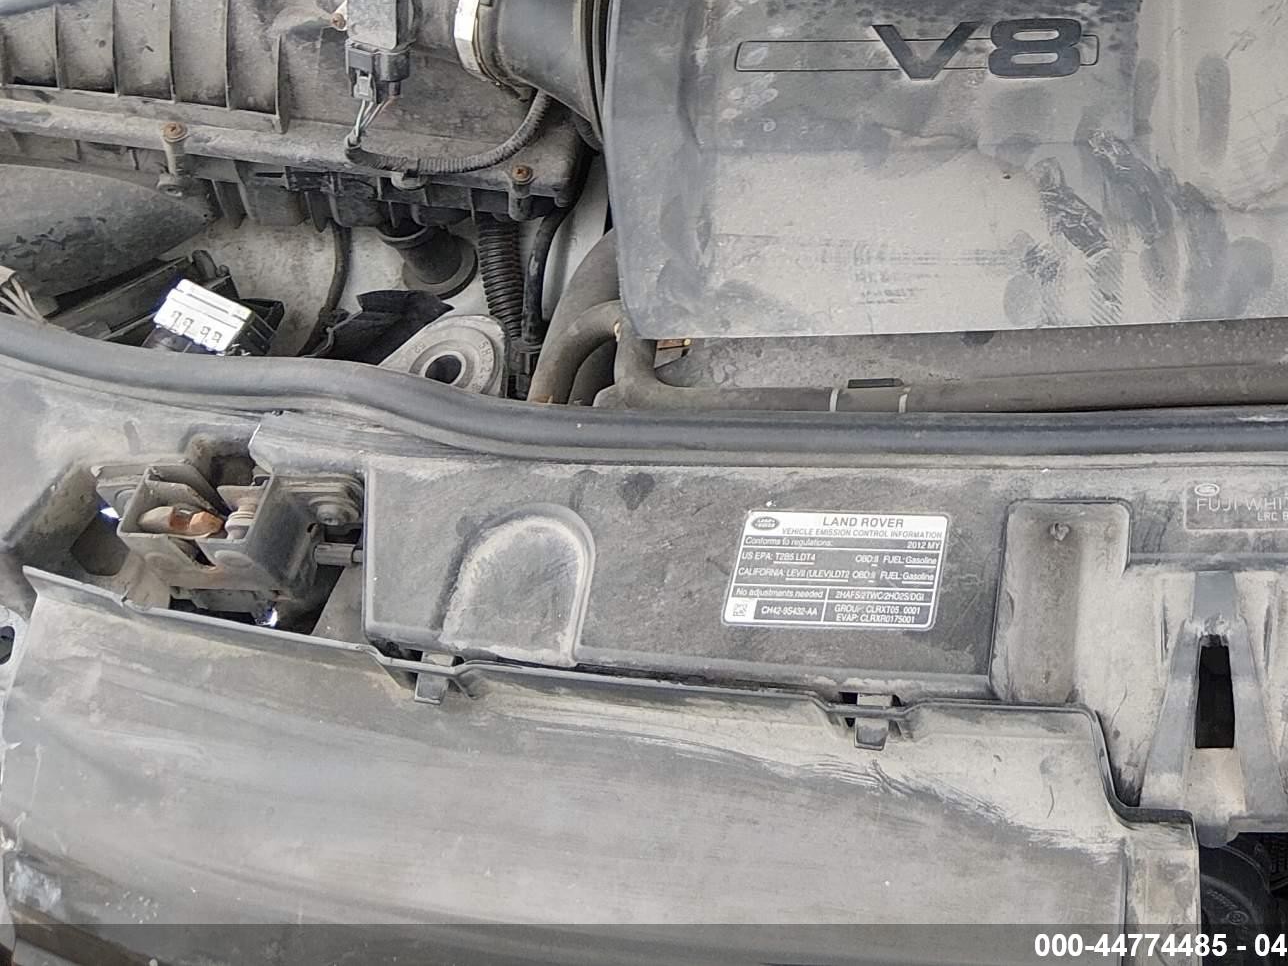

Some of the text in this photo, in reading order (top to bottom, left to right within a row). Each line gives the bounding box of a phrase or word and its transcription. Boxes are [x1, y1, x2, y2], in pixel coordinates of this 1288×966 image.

[872, 18, 1082, 80] V8
[1196, 497, 1238, 512] FUJI
[1257, 512, 1278, 521] LRC
[823, 517, 904, 528] LAND ROVER
[782, 528, 943, 539] VEHICLE EMISSION CONTROL INFORMATION
[745, 537, 780, 545] Conforms
[907, 541, 941, 550] 2012 MY
[741, 551, 754, 560] US
[755, 551, 773, 561] EPA:
[795, 553, 816, 562] LDT4
[735, 588, 823, 598] No adjustments needed
[836, 614, 859, 622] EVAP:
